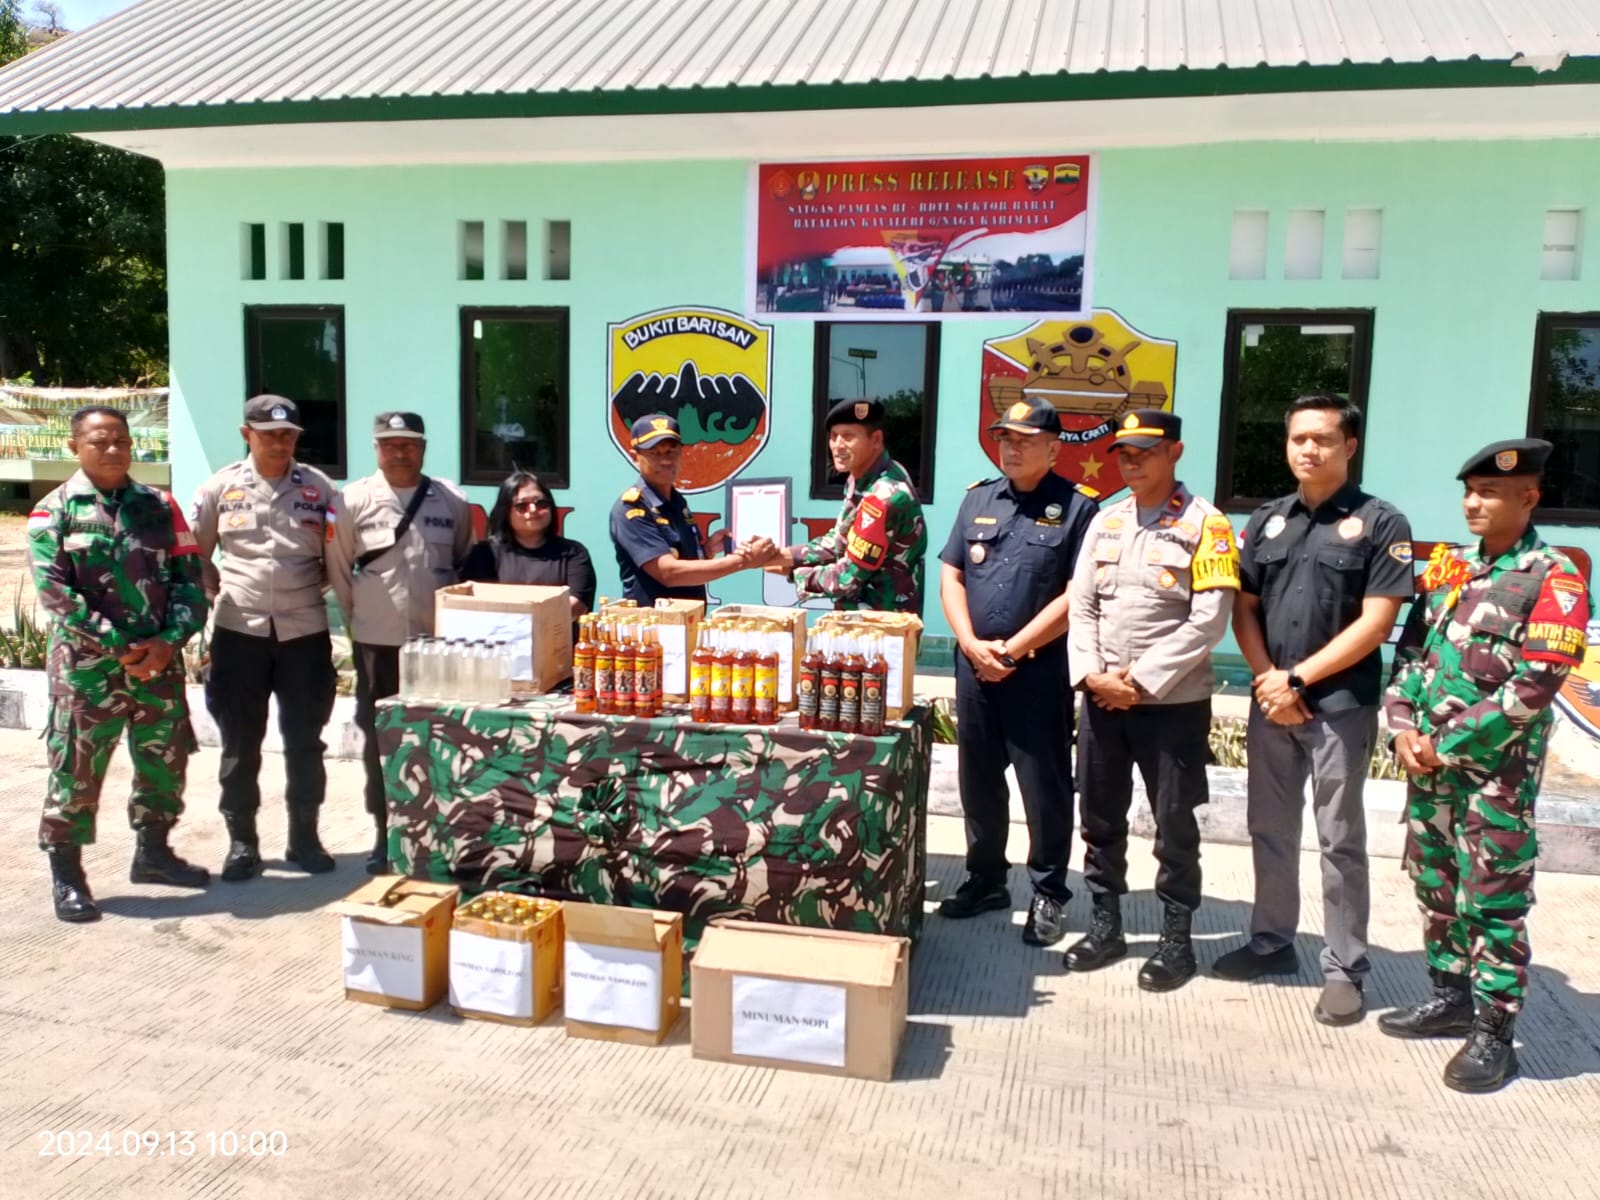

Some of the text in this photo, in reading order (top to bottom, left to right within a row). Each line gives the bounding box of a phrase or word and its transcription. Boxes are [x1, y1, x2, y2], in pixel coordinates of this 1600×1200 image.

[825, 169, 1016, 193] PRESS RELEASE
[788, 204, 834, 215] SATGAS
[838, 203, 888, 214] PAMTAS
[956, 201, 1008, 212] SEKTOR
[1012, 200, 1057, 211] BARAT
[980, 214, 1049, 226] KARIMATA
[623, 316, 751, 348] BUKIT BARISAN
[801, 1018, 829, 1029] SOPI
